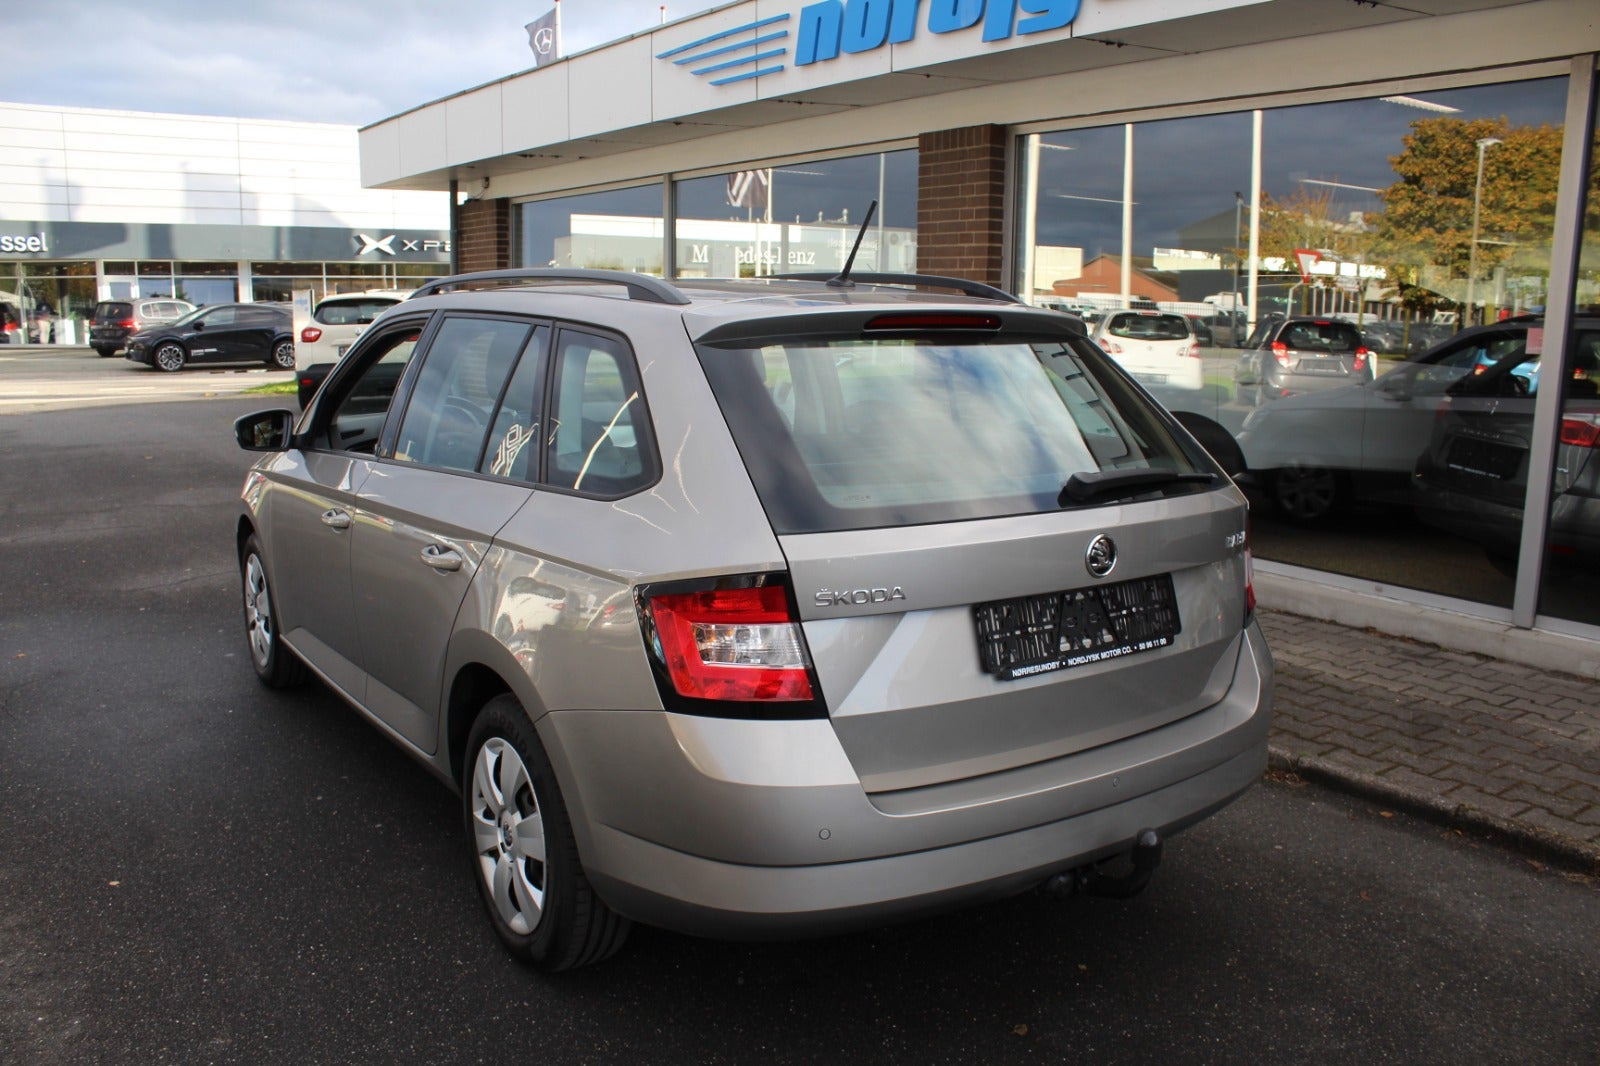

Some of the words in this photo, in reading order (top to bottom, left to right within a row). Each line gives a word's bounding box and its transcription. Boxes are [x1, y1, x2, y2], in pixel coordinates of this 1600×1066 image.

[815, 586, 905, 607] ŠKODA
[1068, 653, 1100, 666] NORDJYSK
[1101, 648, 1121, 659] MOTOR
